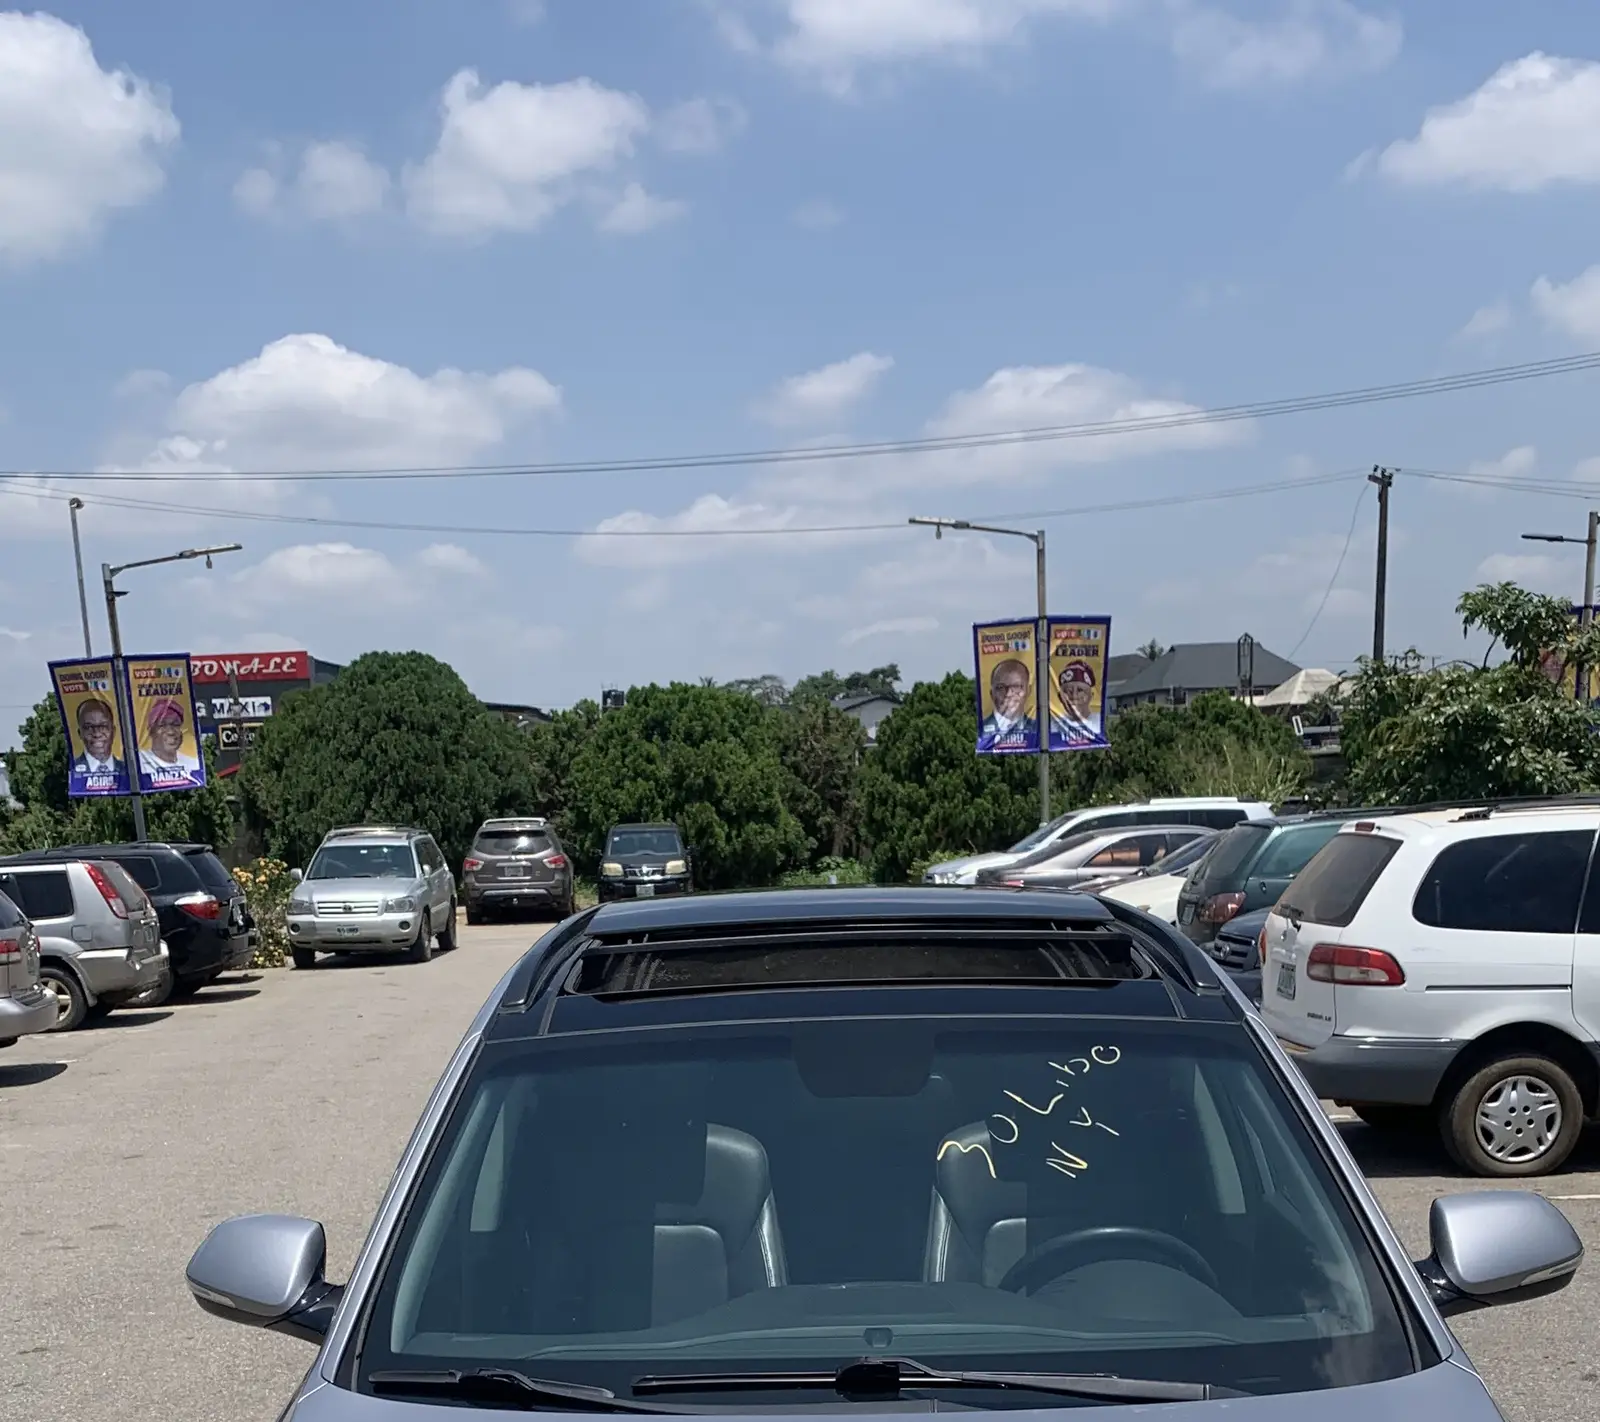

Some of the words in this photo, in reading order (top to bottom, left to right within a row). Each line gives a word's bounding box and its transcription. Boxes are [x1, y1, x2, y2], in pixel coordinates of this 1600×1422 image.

[1055, 647, 1099, 657] LEADER
[134, 669, 156, 678] VOTE
[63, 684, 85, 692] VOTE
[138, 687, 184, 697] LEADER
